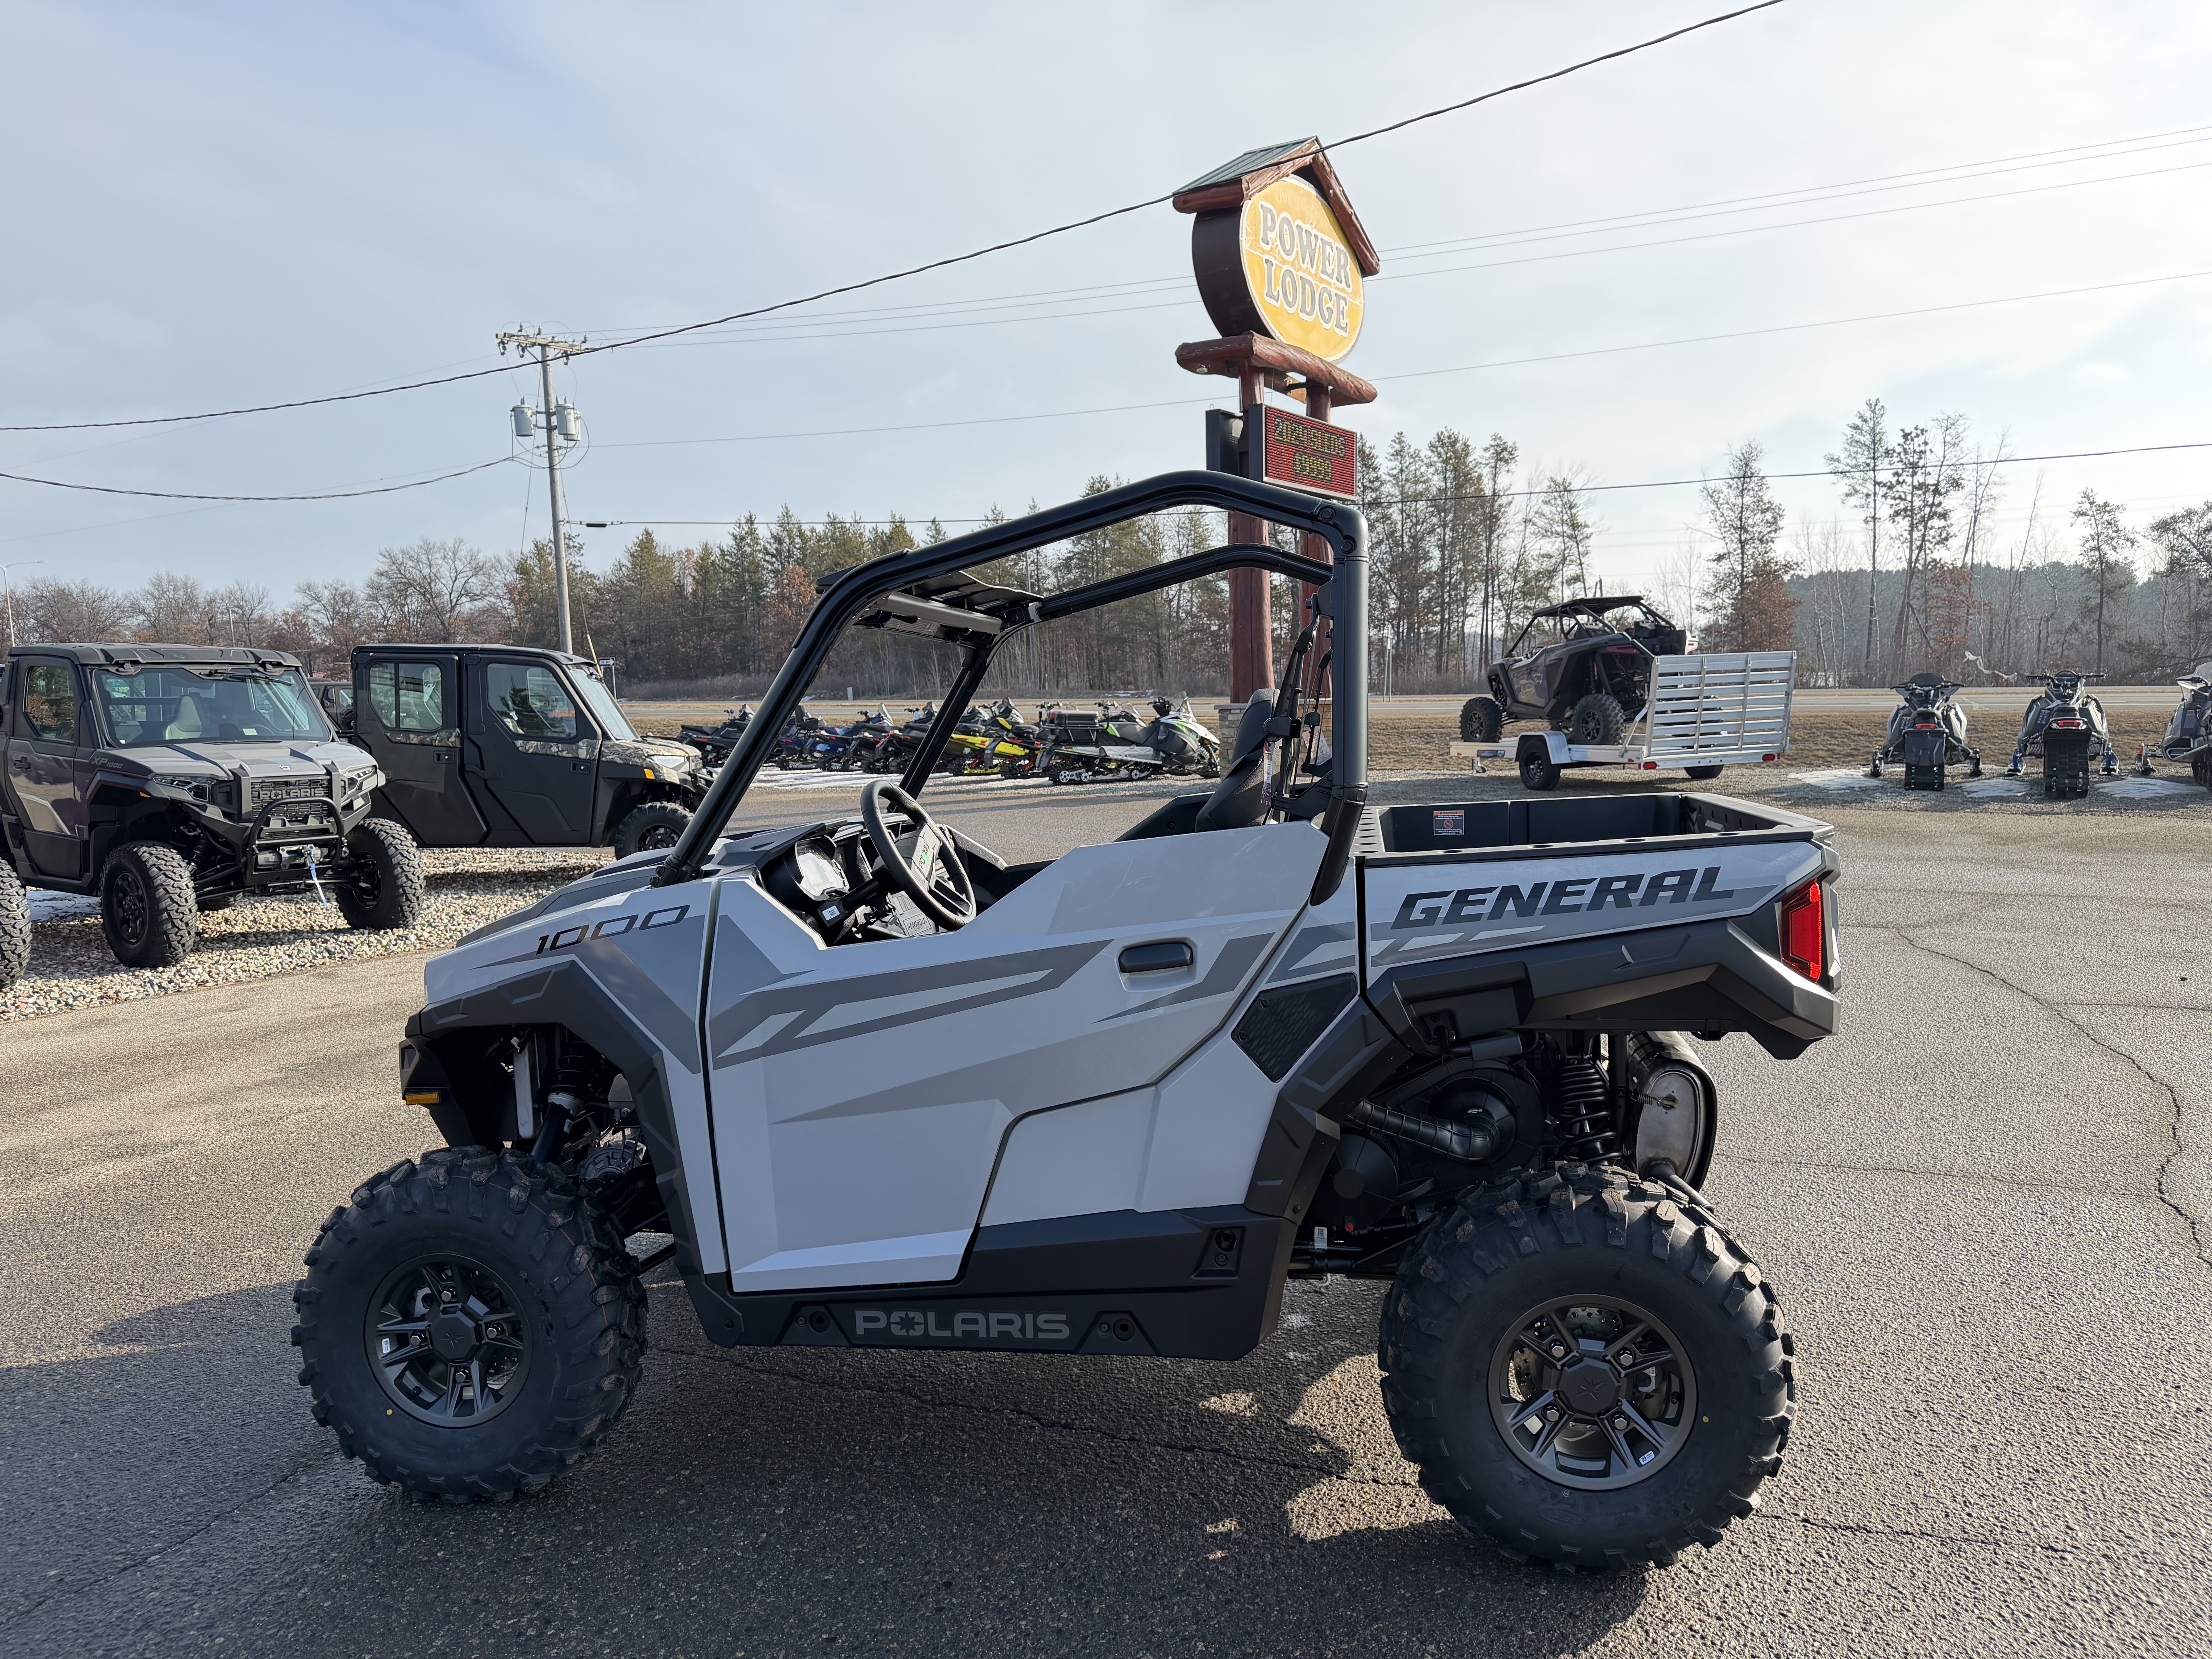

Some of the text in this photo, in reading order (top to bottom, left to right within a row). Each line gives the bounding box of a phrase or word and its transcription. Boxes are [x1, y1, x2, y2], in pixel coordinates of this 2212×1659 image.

[1259, 202, 1351, 290] POWER
[1264, 257, 1348, 335] LODGE
[1274, 418, 1307, 446] 2024
[91, 757, 108, 765] XP
[259, 788, 324, 800] POLARIS
[1391, 866, 1735, 930] GENERAL
[536, 905, 690, 955] 1000
[855, 1310, 1070, 1339] POLARIS
